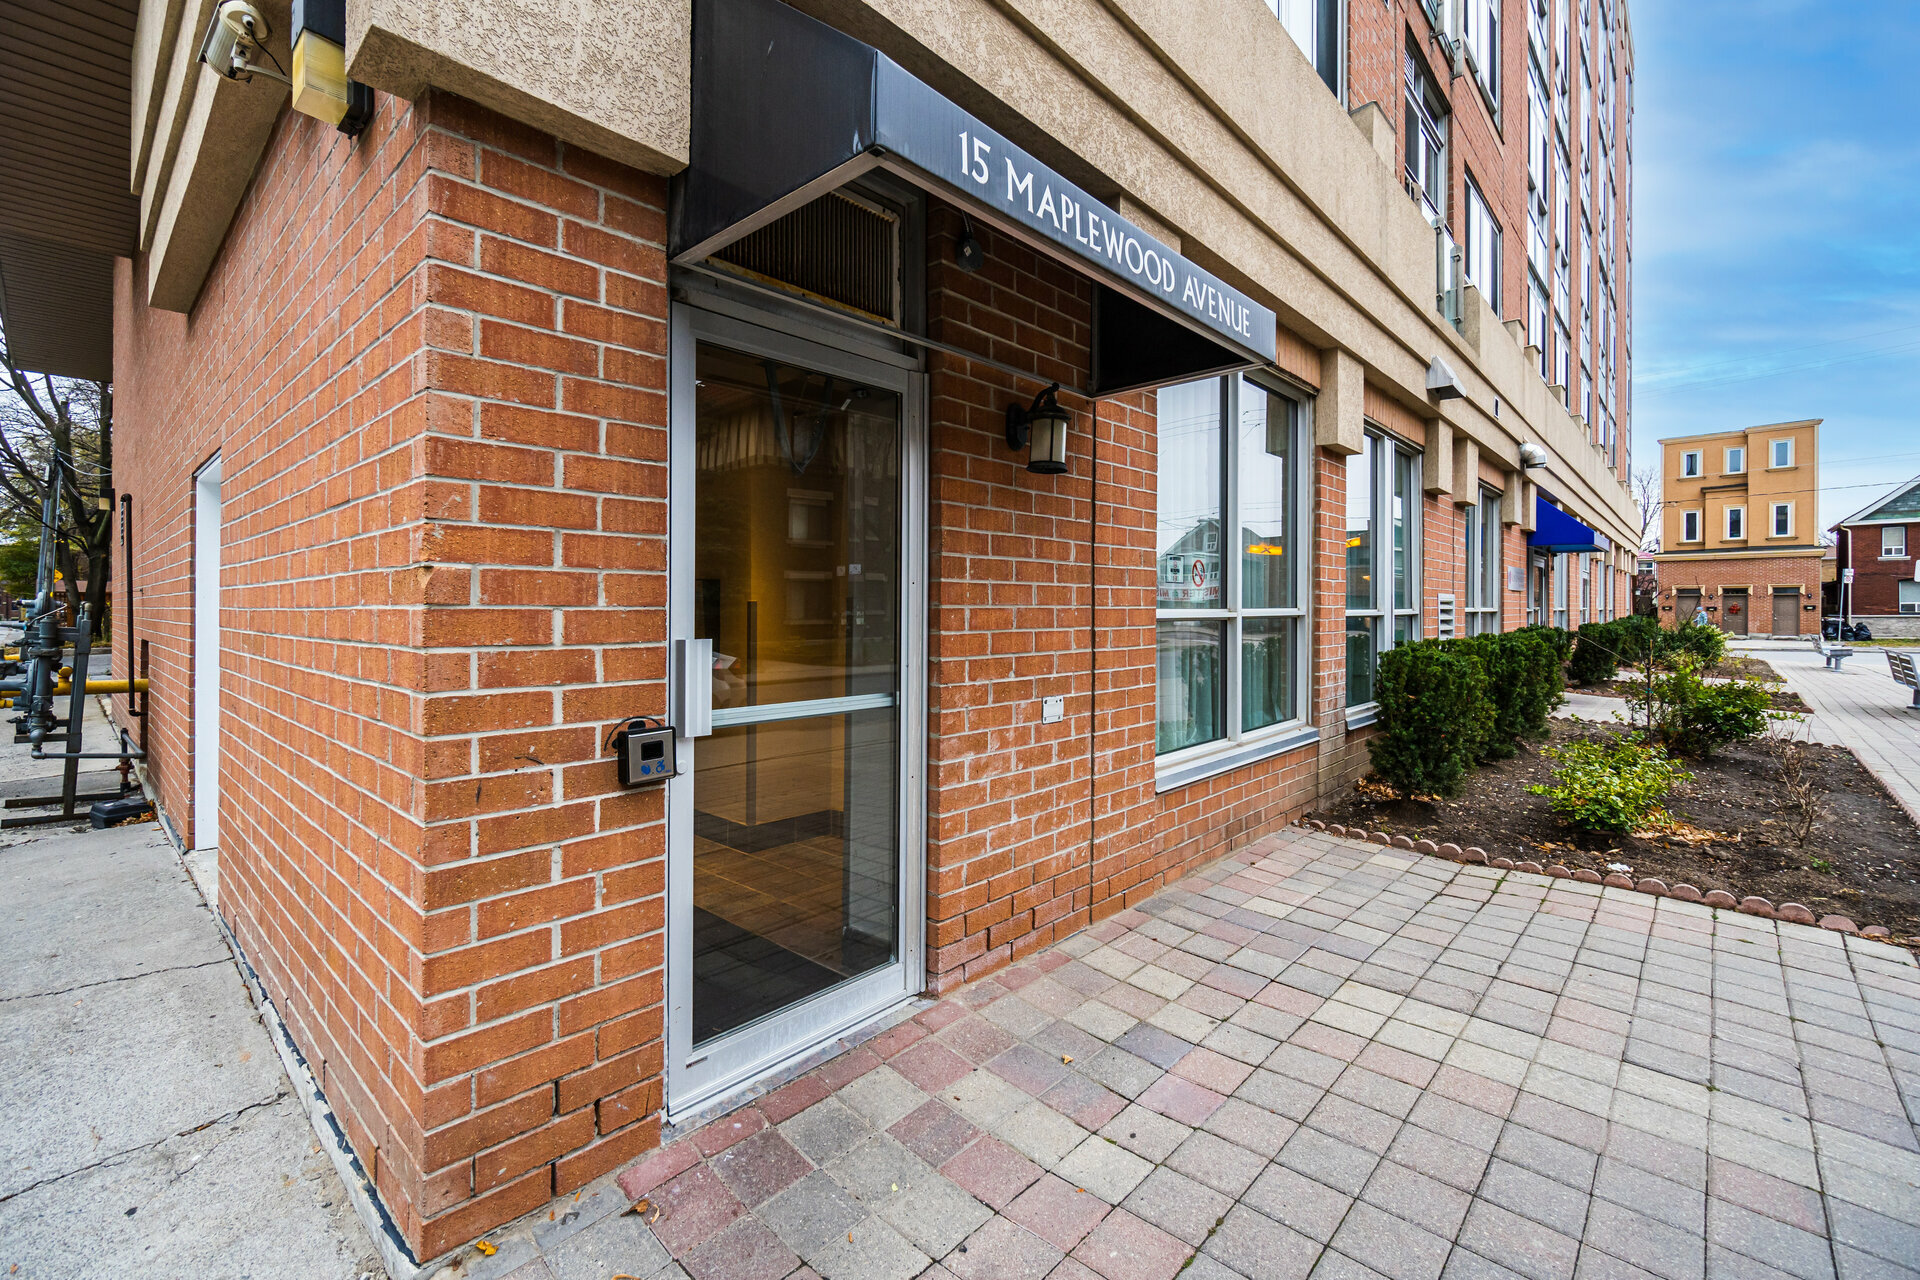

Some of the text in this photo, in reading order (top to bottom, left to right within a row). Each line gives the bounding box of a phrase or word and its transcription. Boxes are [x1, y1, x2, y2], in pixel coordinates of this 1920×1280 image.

[958, 131, 1251, 338] 15 MAPLEWOOD AVENUE
